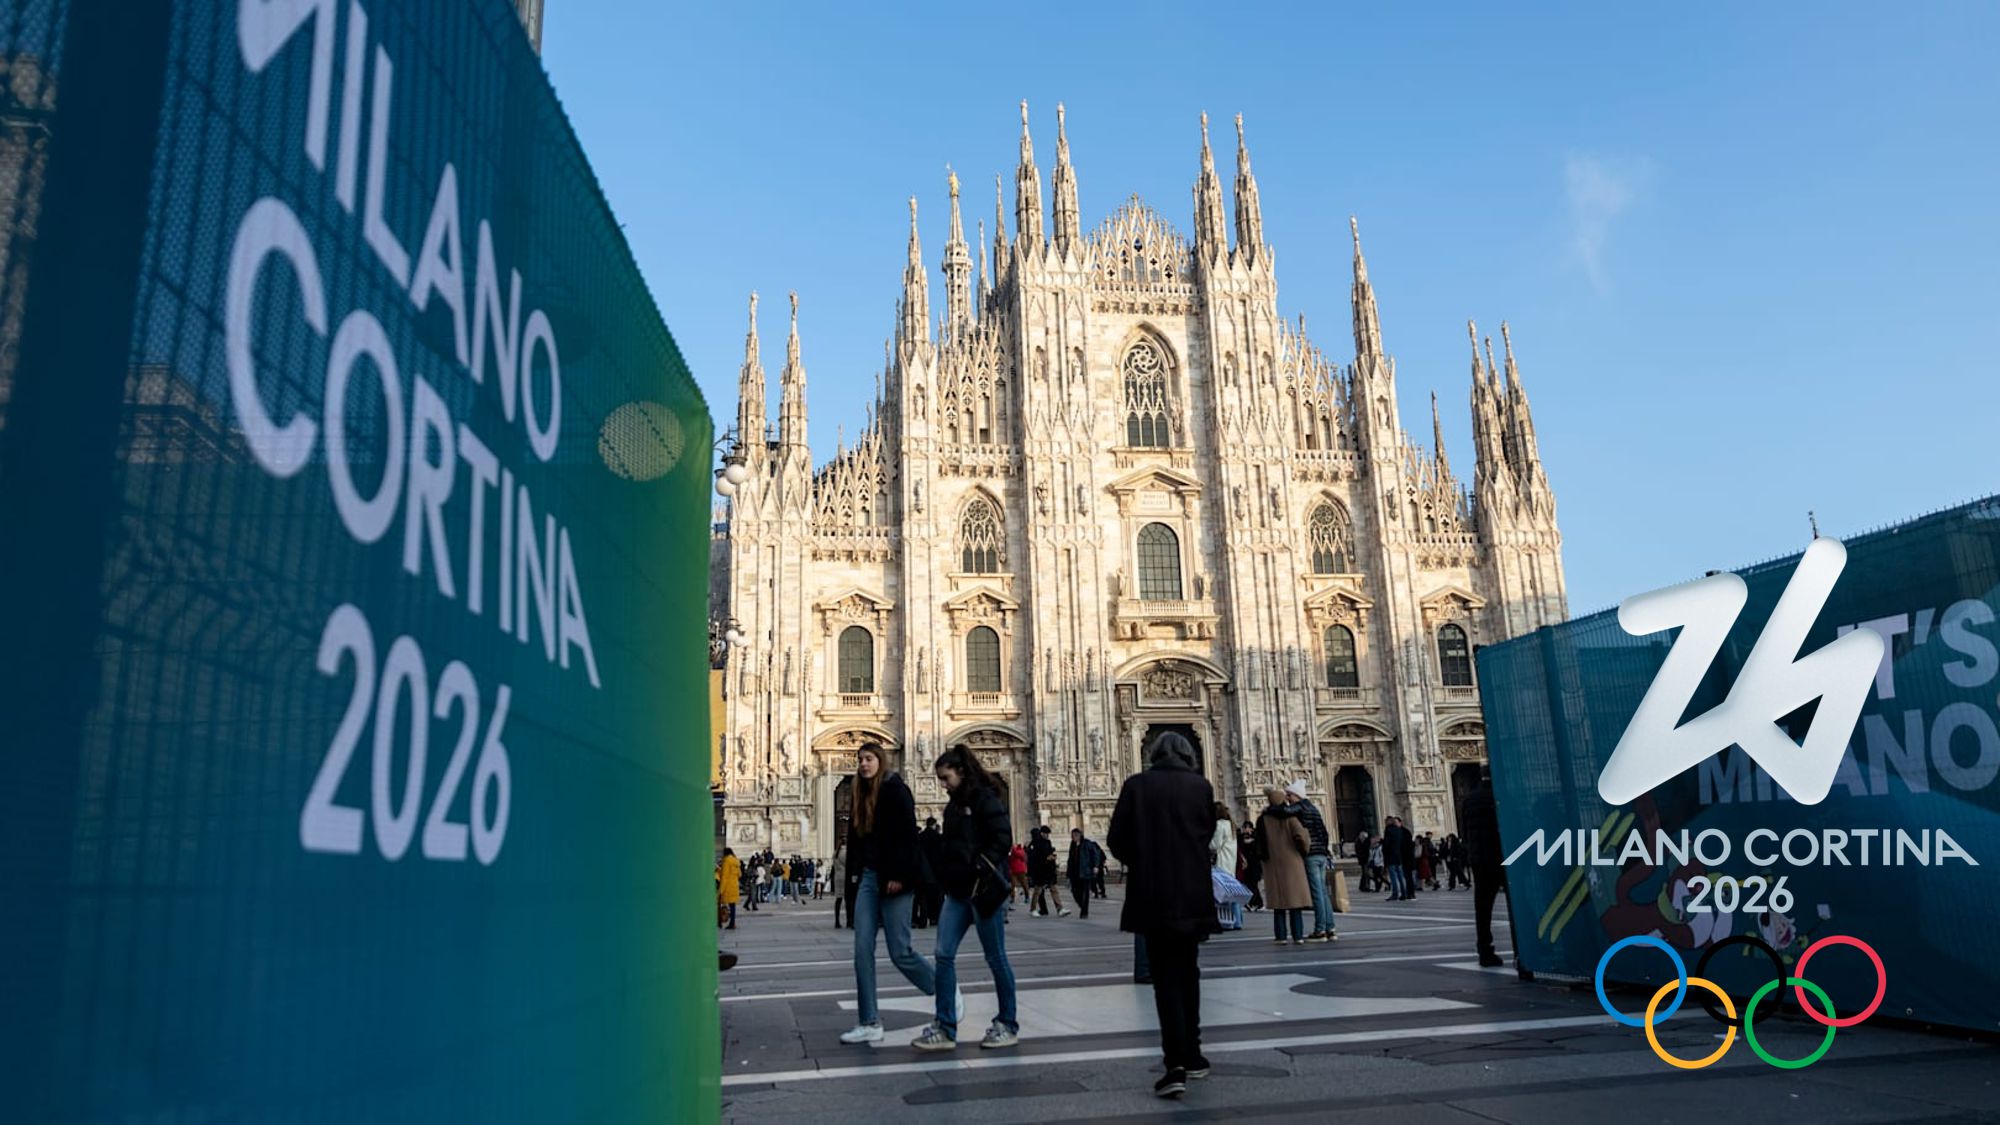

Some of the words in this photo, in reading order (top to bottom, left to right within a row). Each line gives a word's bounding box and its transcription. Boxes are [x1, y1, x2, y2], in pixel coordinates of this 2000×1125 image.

[225, 197, 601, 689] CORTINA
[300, 603, 512, 866] 2026
[1837, 598, 2000, 700] T'S
[1698, 702, 2000, 805] MNO
